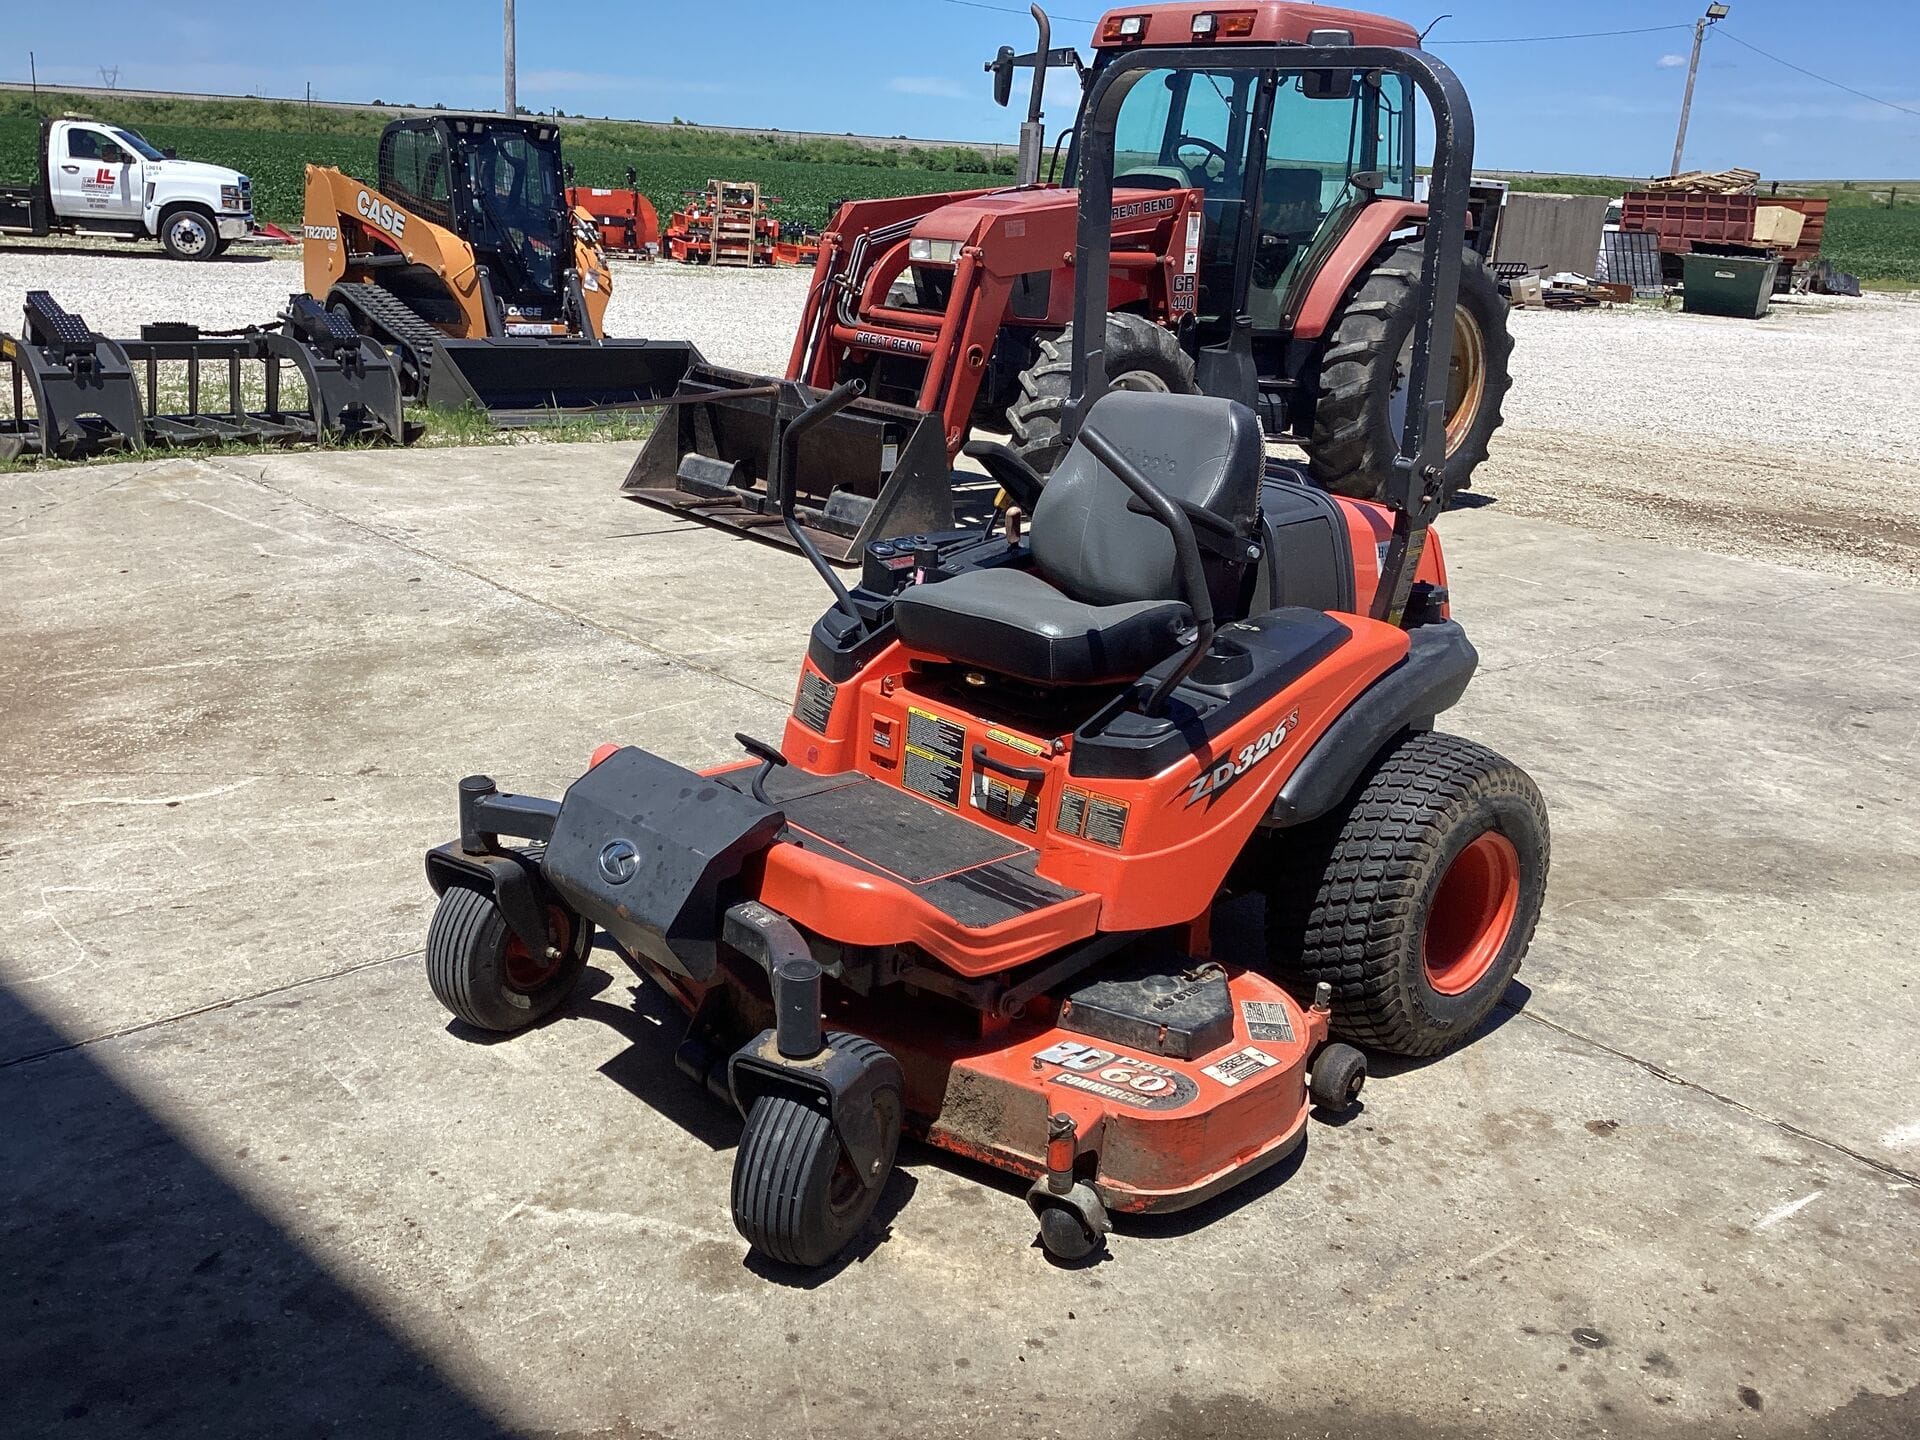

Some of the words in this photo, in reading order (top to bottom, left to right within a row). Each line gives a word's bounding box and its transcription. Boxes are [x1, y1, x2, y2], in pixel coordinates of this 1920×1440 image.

[357, 190, 406, 239] CASE
[1111, 203, 1140, 220] REAT
[1142, 197, 1174, 214] BEND
[304, 225, 338, 240] TR270B
[1173, 275, 1195, 293] GB
[507, 306, 542, 316] CASE
[1172, 295, 1194, 311] 440
[855, 331, 890, 348] GREAT
[891, 338, 923, 353] BEND
[1032, 1041, 1116, 1072] ZD
[1055, 1073, 1154, 1107] COMMERCIAL
[1100, 1068, 1168, 1092] 60
